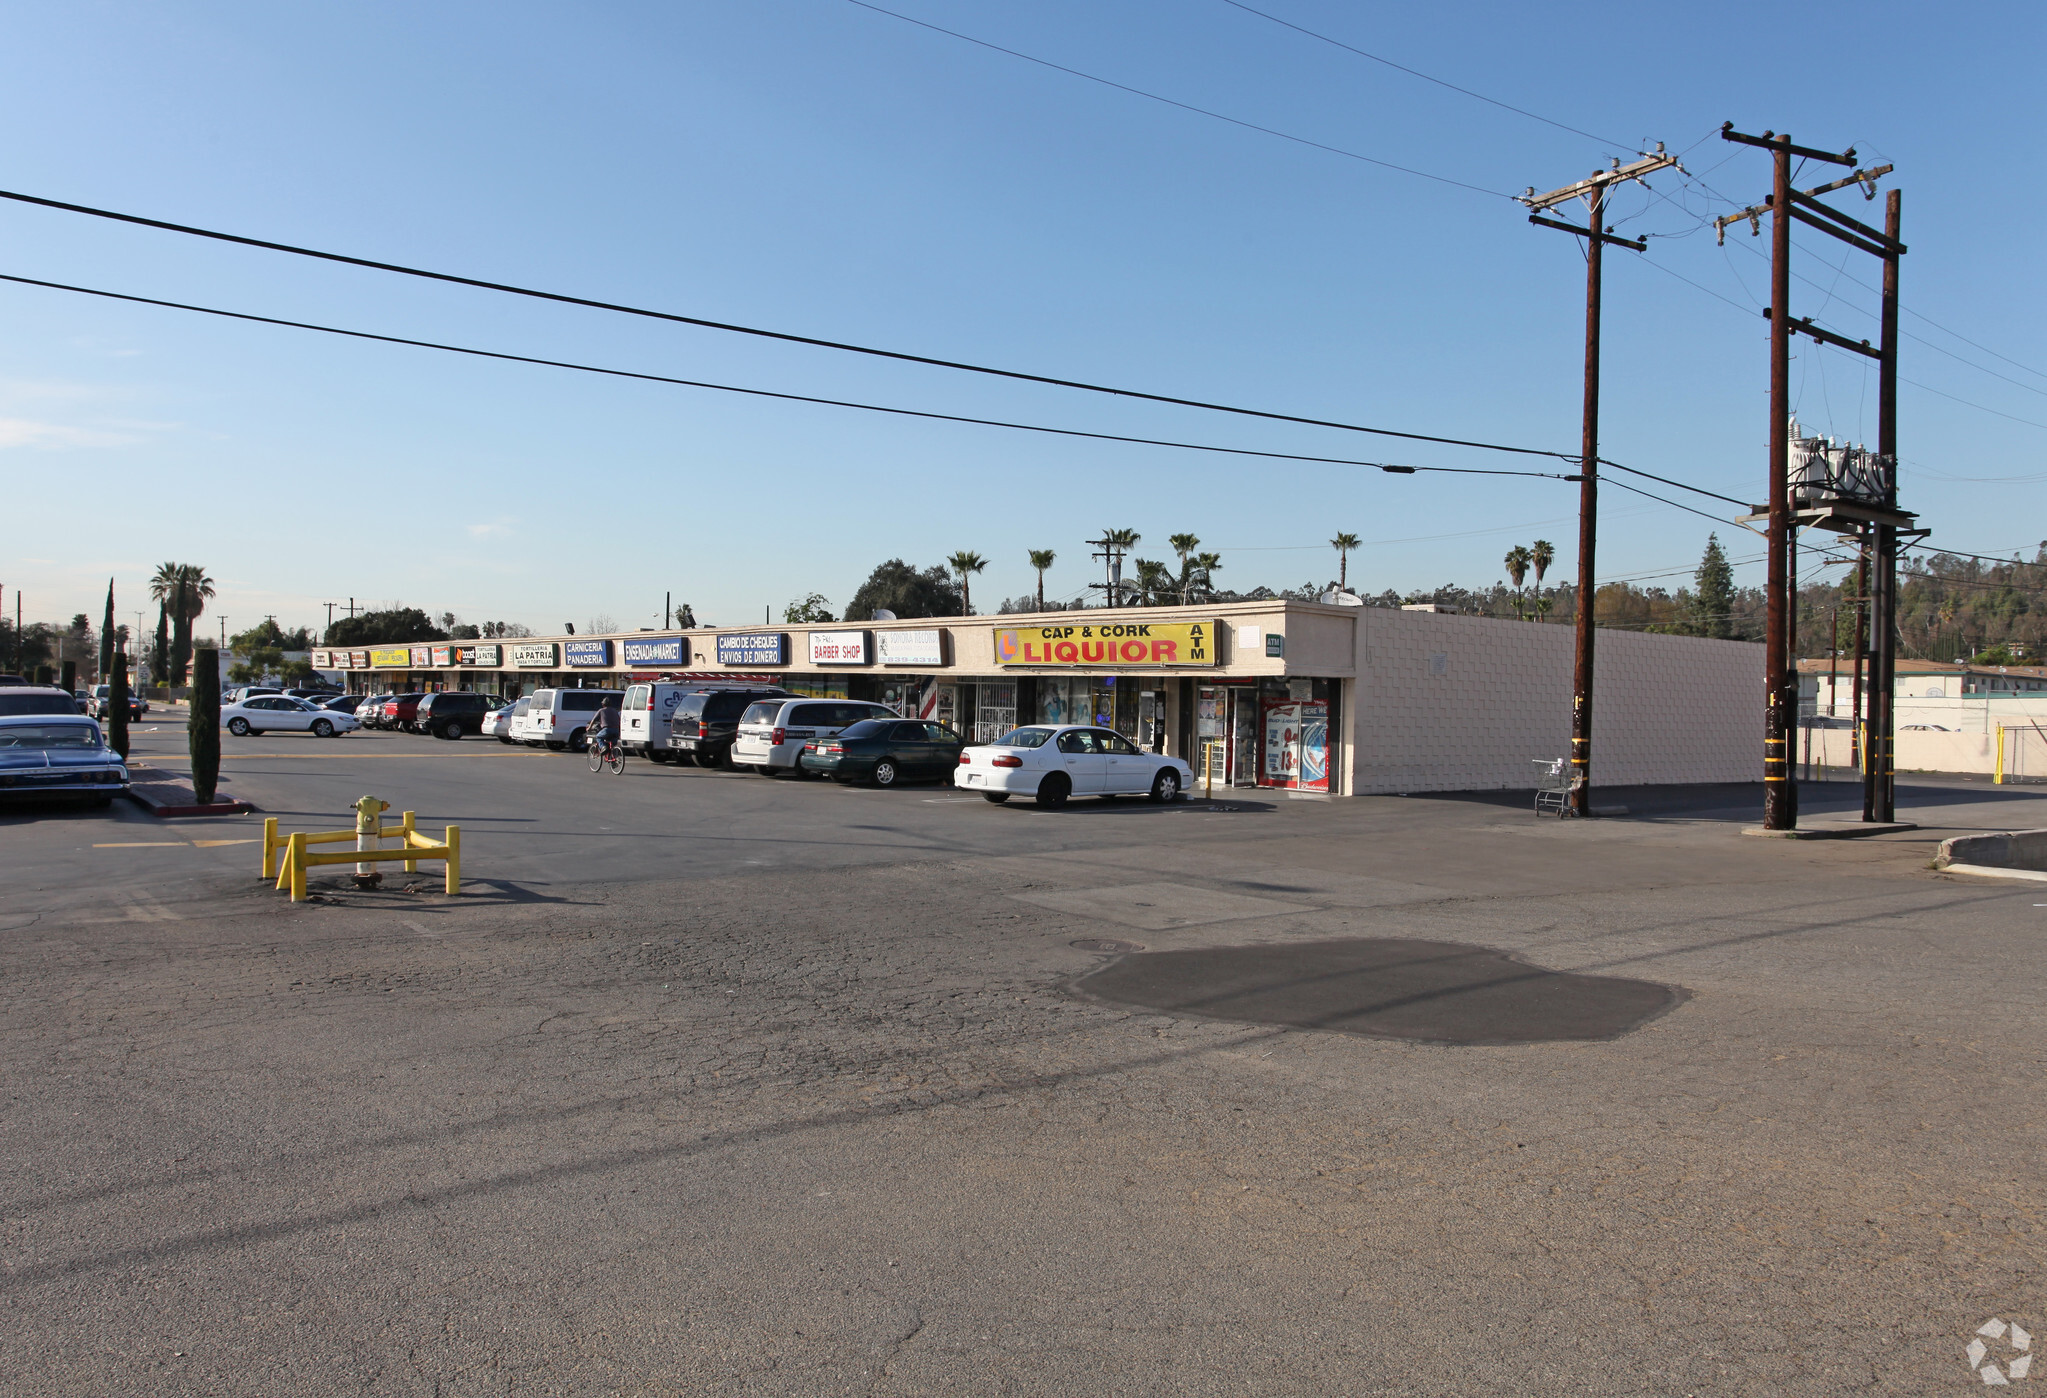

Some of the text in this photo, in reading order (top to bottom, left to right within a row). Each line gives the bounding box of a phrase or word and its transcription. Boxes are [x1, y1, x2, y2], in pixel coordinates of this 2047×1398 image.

[1041, 625, 1151, 639] CAP & CORK
[567, 643, 602, 652] CARNICERIA
[719, 636, 778, 649] CAMBIO DE CHEQUES
[515, 651, 553, 660] LA PATRIA
[626, 643, 680, 660] ENSENADA MARKET
[720, 650, 777, 662] ENVIOS DE DINERO
[814, 645, 860, 659] BARBER SHOP
[1023, 640, 1178, 663] LIQUIOR
[567, 654, 603, 664] PANADERIA
[1302, 706, 1317, 715] HERE
